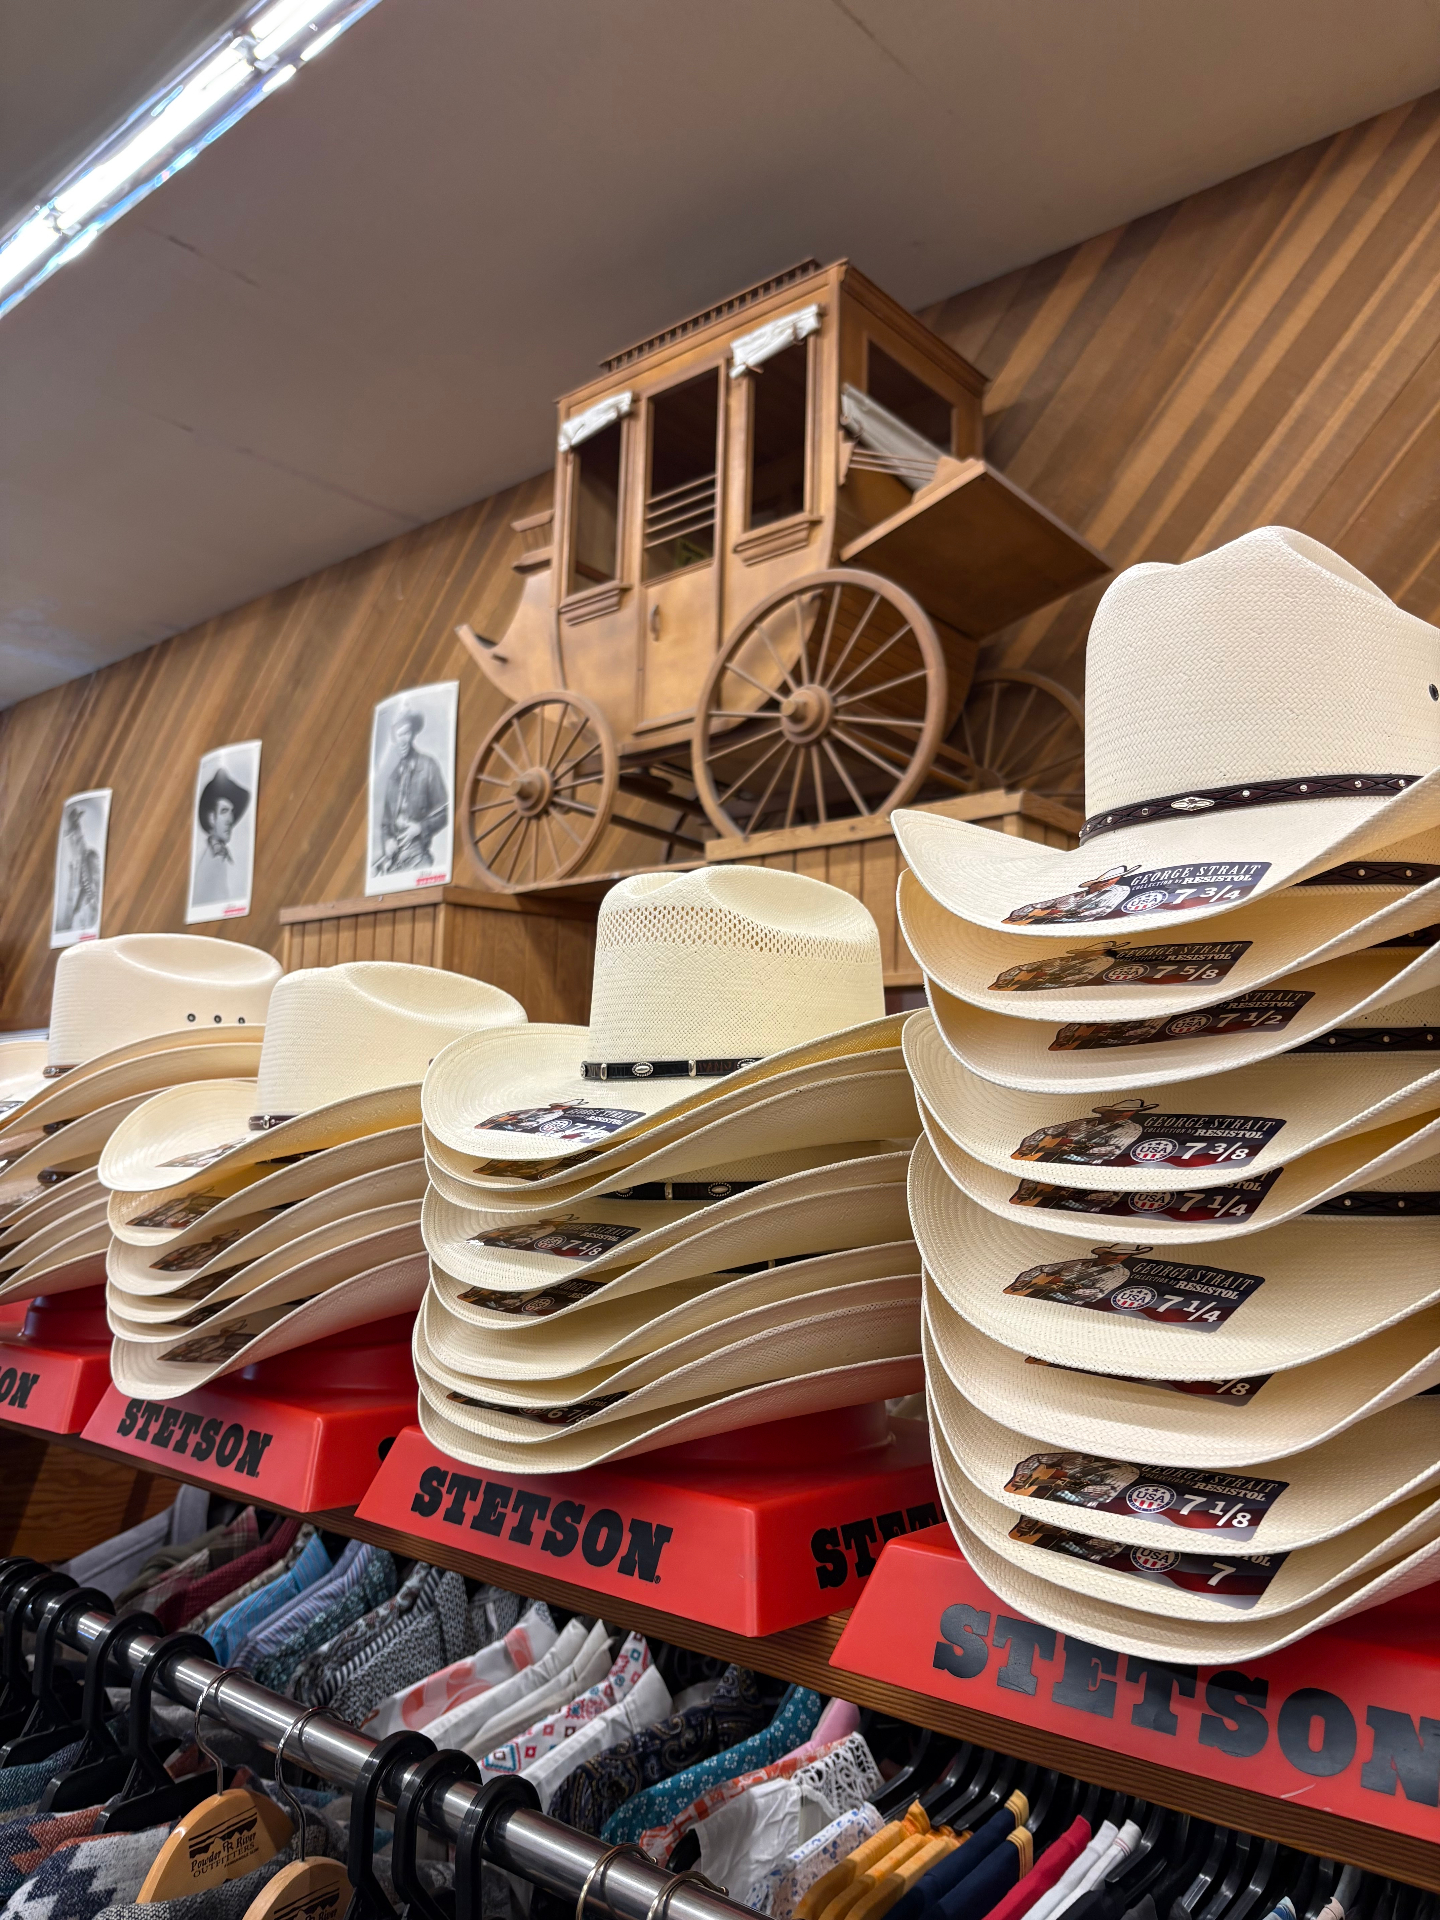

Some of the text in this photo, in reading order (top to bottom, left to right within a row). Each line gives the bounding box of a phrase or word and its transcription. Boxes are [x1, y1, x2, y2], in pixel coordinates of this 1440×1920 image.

[1130, 864, 1262, 886] GEORGE STRAIT
[1183, 875, 1252, 885] RESISTOL
[1171, 885, 1241, 905] 7 3/4
[1116, 943, 1243, 959] GEORGE STRAIT
[1166, 953, 1232, 962] RESISTOL
[1152, 963, 1219, 981] 7 5/8
[1226, 1001, 1296, 1009] RESISTOL
[1241, 992, 1306, 1001] STRAIT
[1215, 1010, 1283, 1028] 7 1/2
[1144, 1116, 1276, 1131] GEORGE STRAIT
[1193, 1129, 1264, 1139] RESISTOL
[1139, 1146, 1167, 1154] USA
[1181, 1142, 1250, 1162] 7 3/8
[1137, 1193, 1166, 1204] USA
[1179, 1192, 1248, 1217] 7 1/4
[561, 1239, 603, 1256] 7 1/8
[1132, 1262, 1255, 1291] GEORGE STRAIT
[1120, 1292, 1147, 1303] USA
[1175, 1280, 1240, 1300] RESISTOL
[1156, 1294, 1222, 1323] 7 1/4
[116, 1397, 274, 1479] STETSON
[1141, 1464, 1279, 1493] GEORGE STRAIT
[1136, 1490, 1165, 1504] USA
[1193, 1482, 1267, 1502] RESISTOL
[1179, 1494, 1252, 1528] 7 1/8
[410, 1465, 674, 1583] STETSON
[1140, 1548, 1169, 1564] USA
[1206, 1561, 1237, 1587] 7
[190, 1850, 222, 1873] Powder
[236, 1832, 257, 1849] River
[192, 1842, 255, 1878] OUTFITTERS
